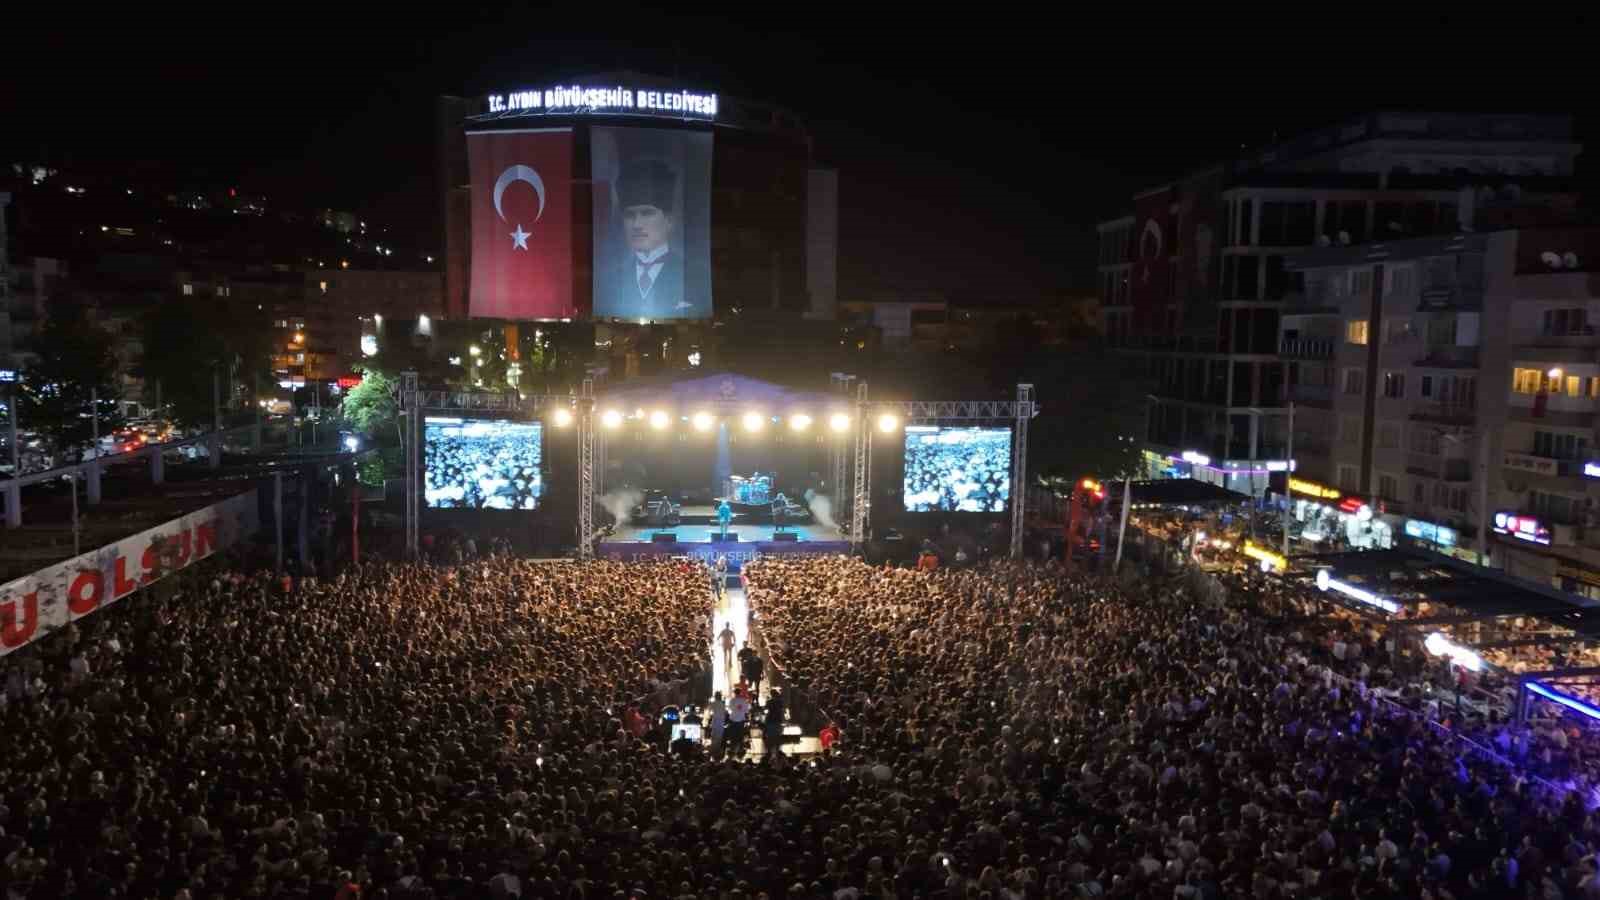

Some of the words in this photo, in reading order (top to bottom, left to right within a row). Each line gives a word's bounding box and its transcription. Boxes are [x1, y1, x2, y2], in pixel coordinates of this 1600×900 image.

[508, 92, 541, 110] AYDIN
[545, 85, 633, 111] BÜYÜKŞEHİR
[637, 90, 717, 114] BELEDİYESİ
